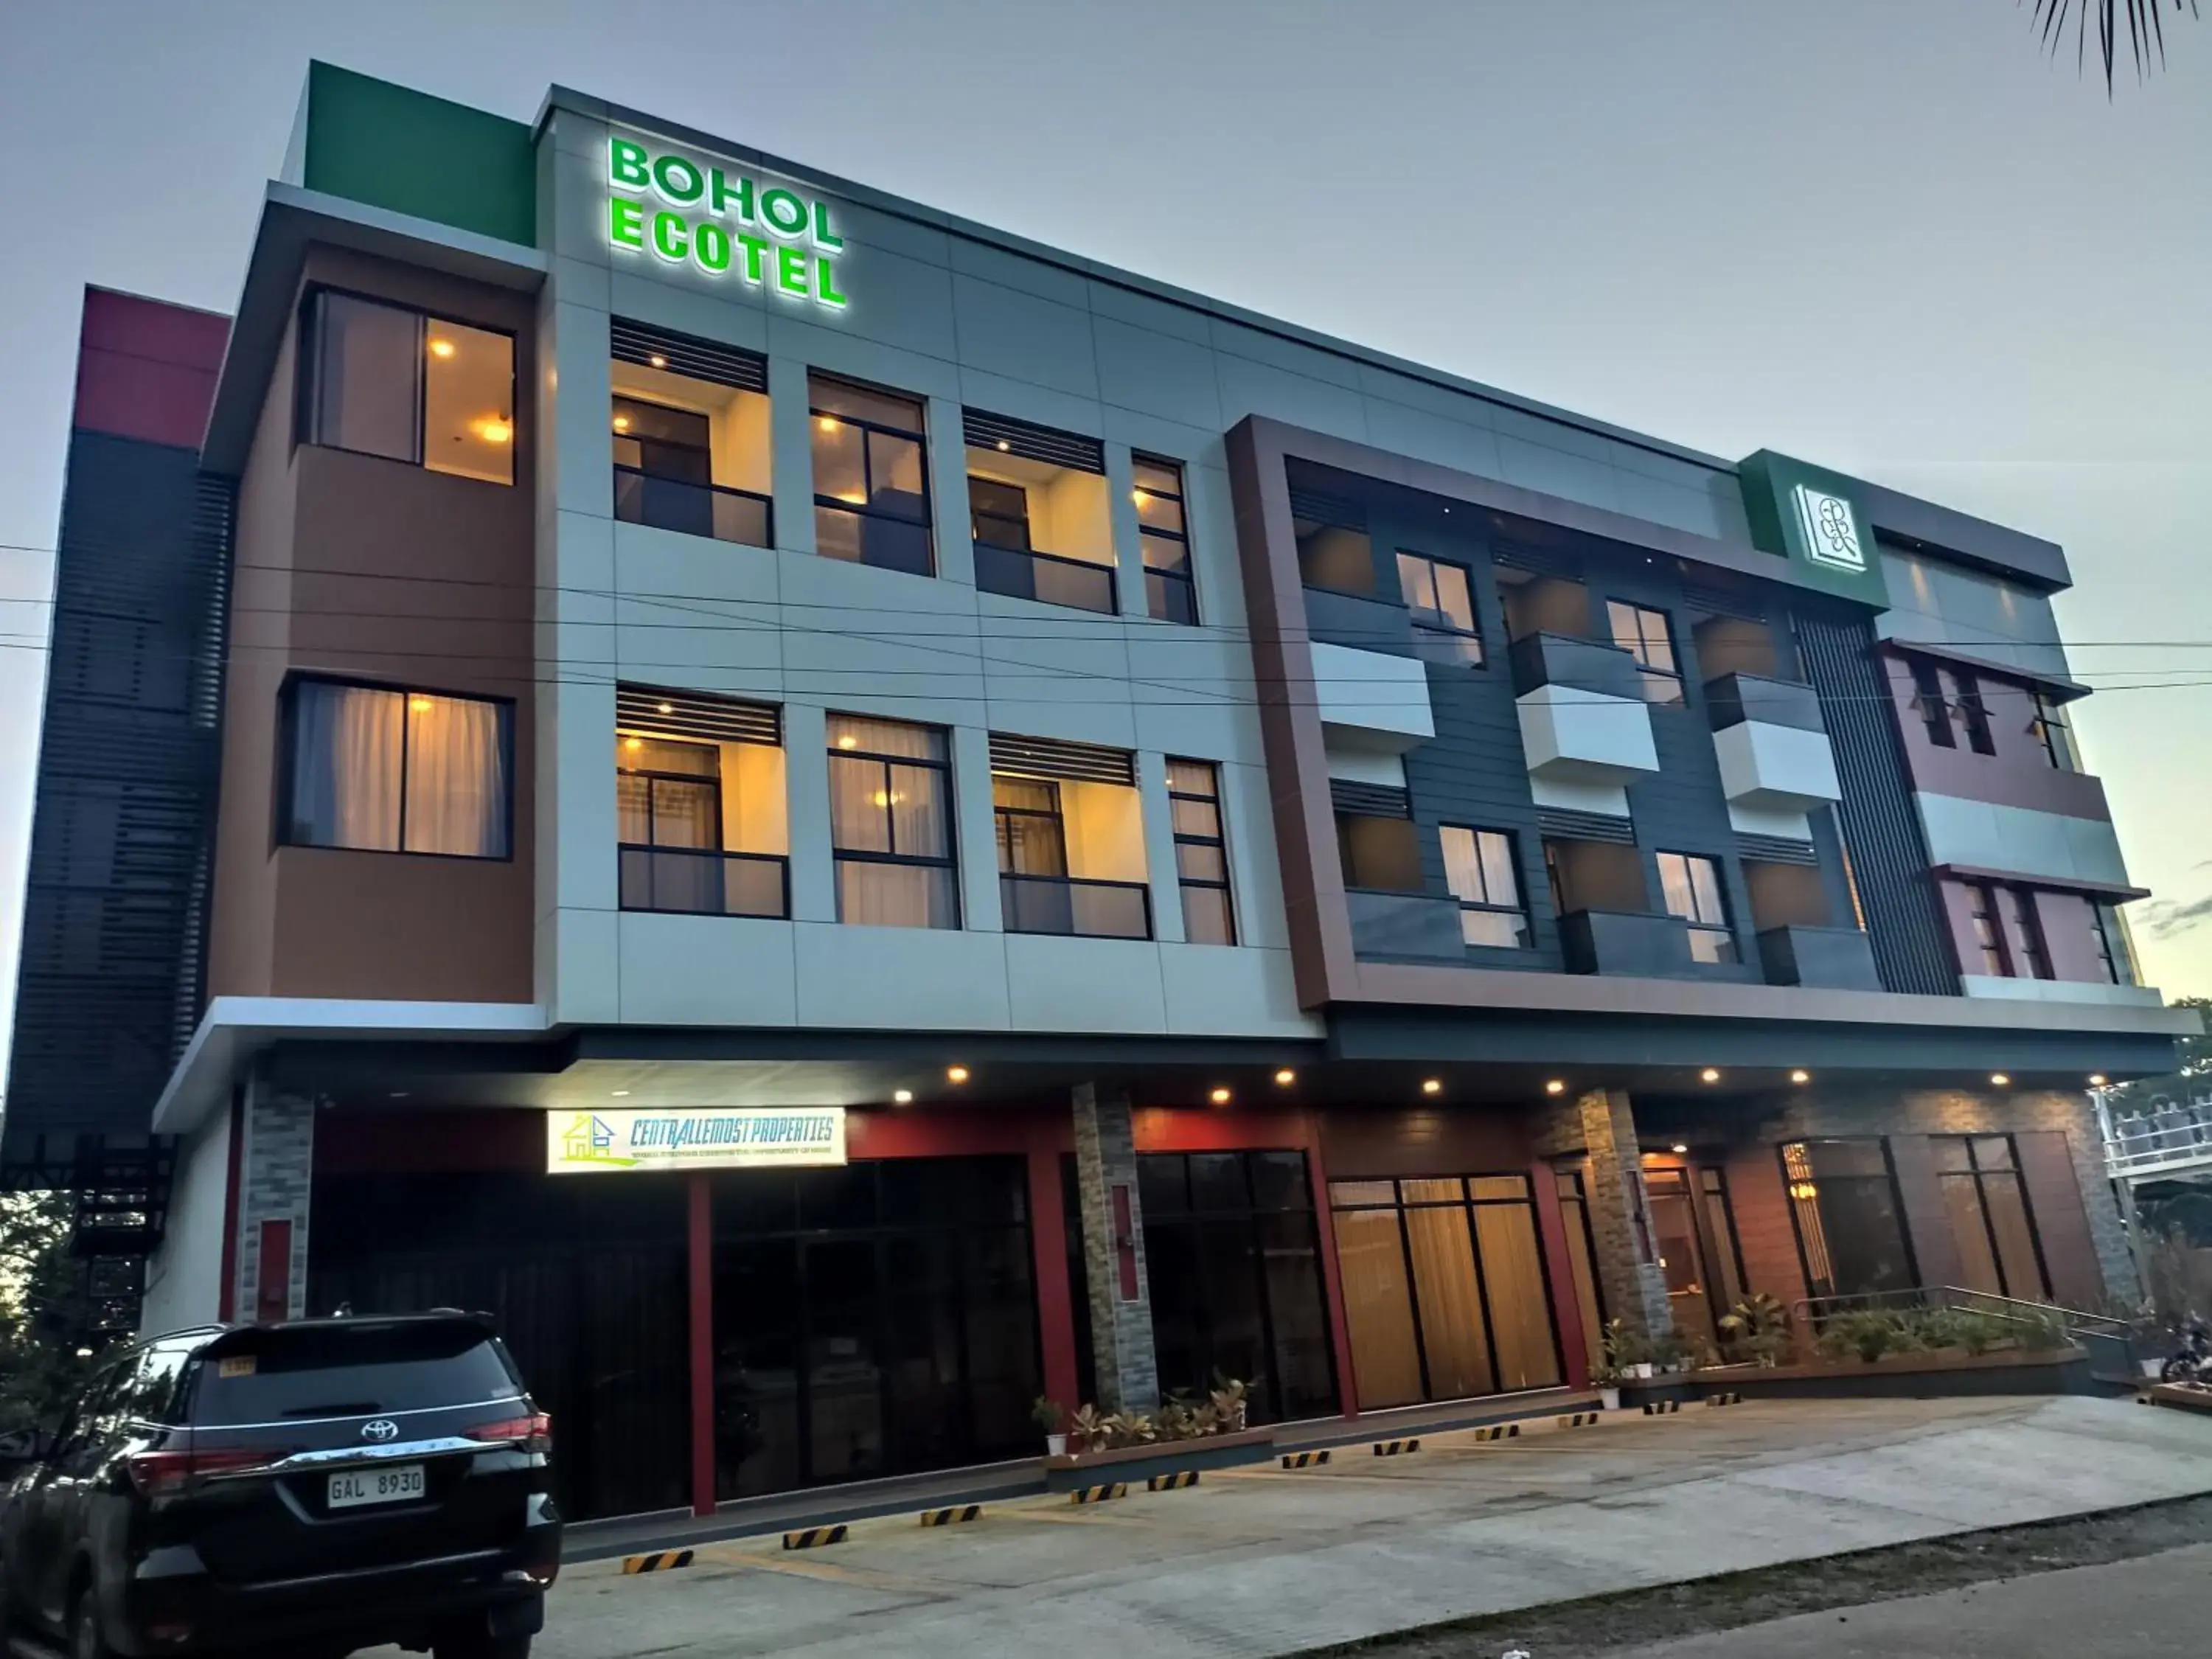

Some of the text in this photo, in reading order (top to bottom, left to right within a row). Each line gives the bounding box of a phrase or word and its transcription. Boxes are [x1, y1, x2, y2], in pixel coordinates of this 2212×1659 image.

[609, 136, 844, 254] BOHOL
[609, 197, 848, 310] ECOTEL
[630, 1116, 834, 1149] CENTRALLEMOST PROPERTIES
[332, 1478, 365, 1500] GAL
